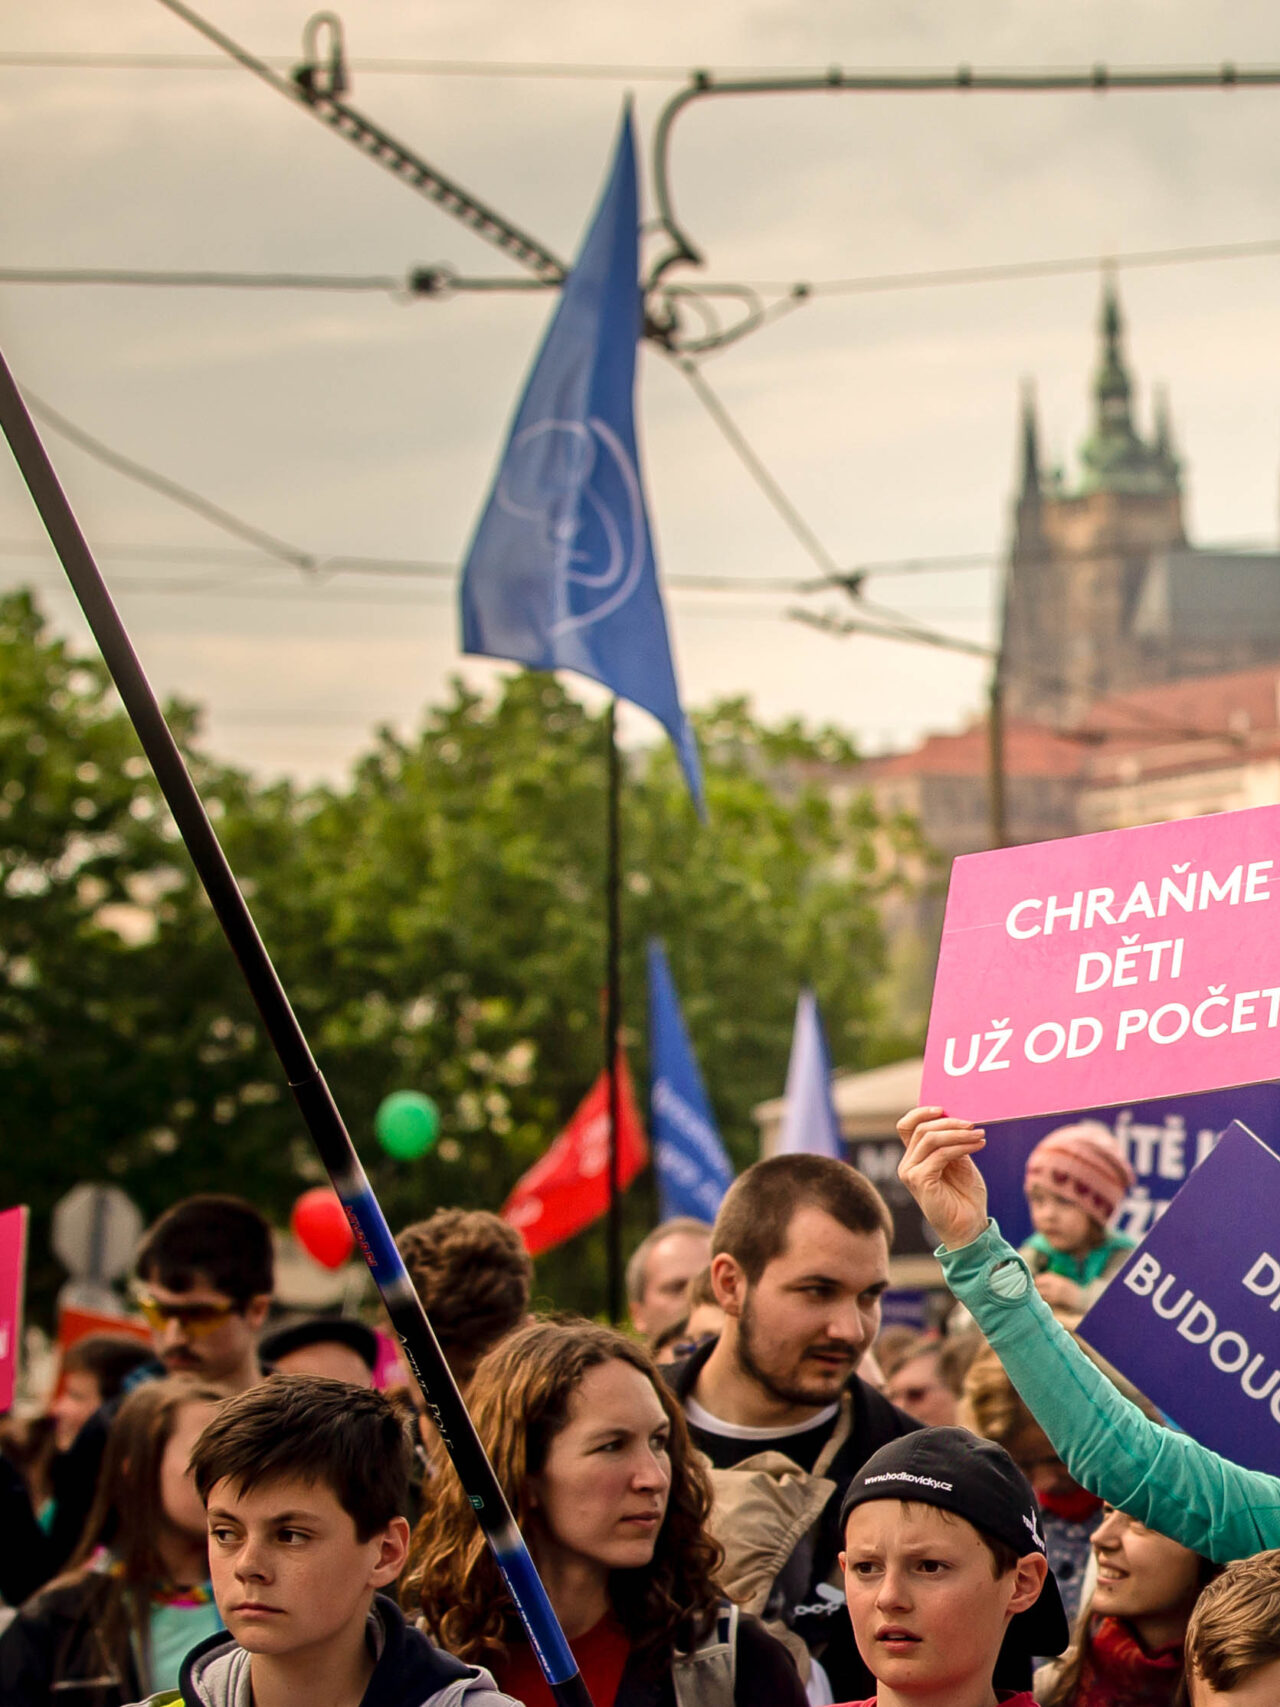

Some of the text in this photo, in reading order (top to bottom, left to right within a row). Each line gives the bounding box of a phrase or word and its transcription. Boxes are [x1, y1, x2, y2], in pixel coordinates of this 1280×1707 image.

[1006, 861, 1274, 940] CHRAŇME
[1075, 933, 1185, 994] DĚTI
[942, 1017, 1015, 1077] UŽ
[1023, 1016, 1104, 1064] OD
[1113, 1110, 1187, 1180] ÍTĚ
